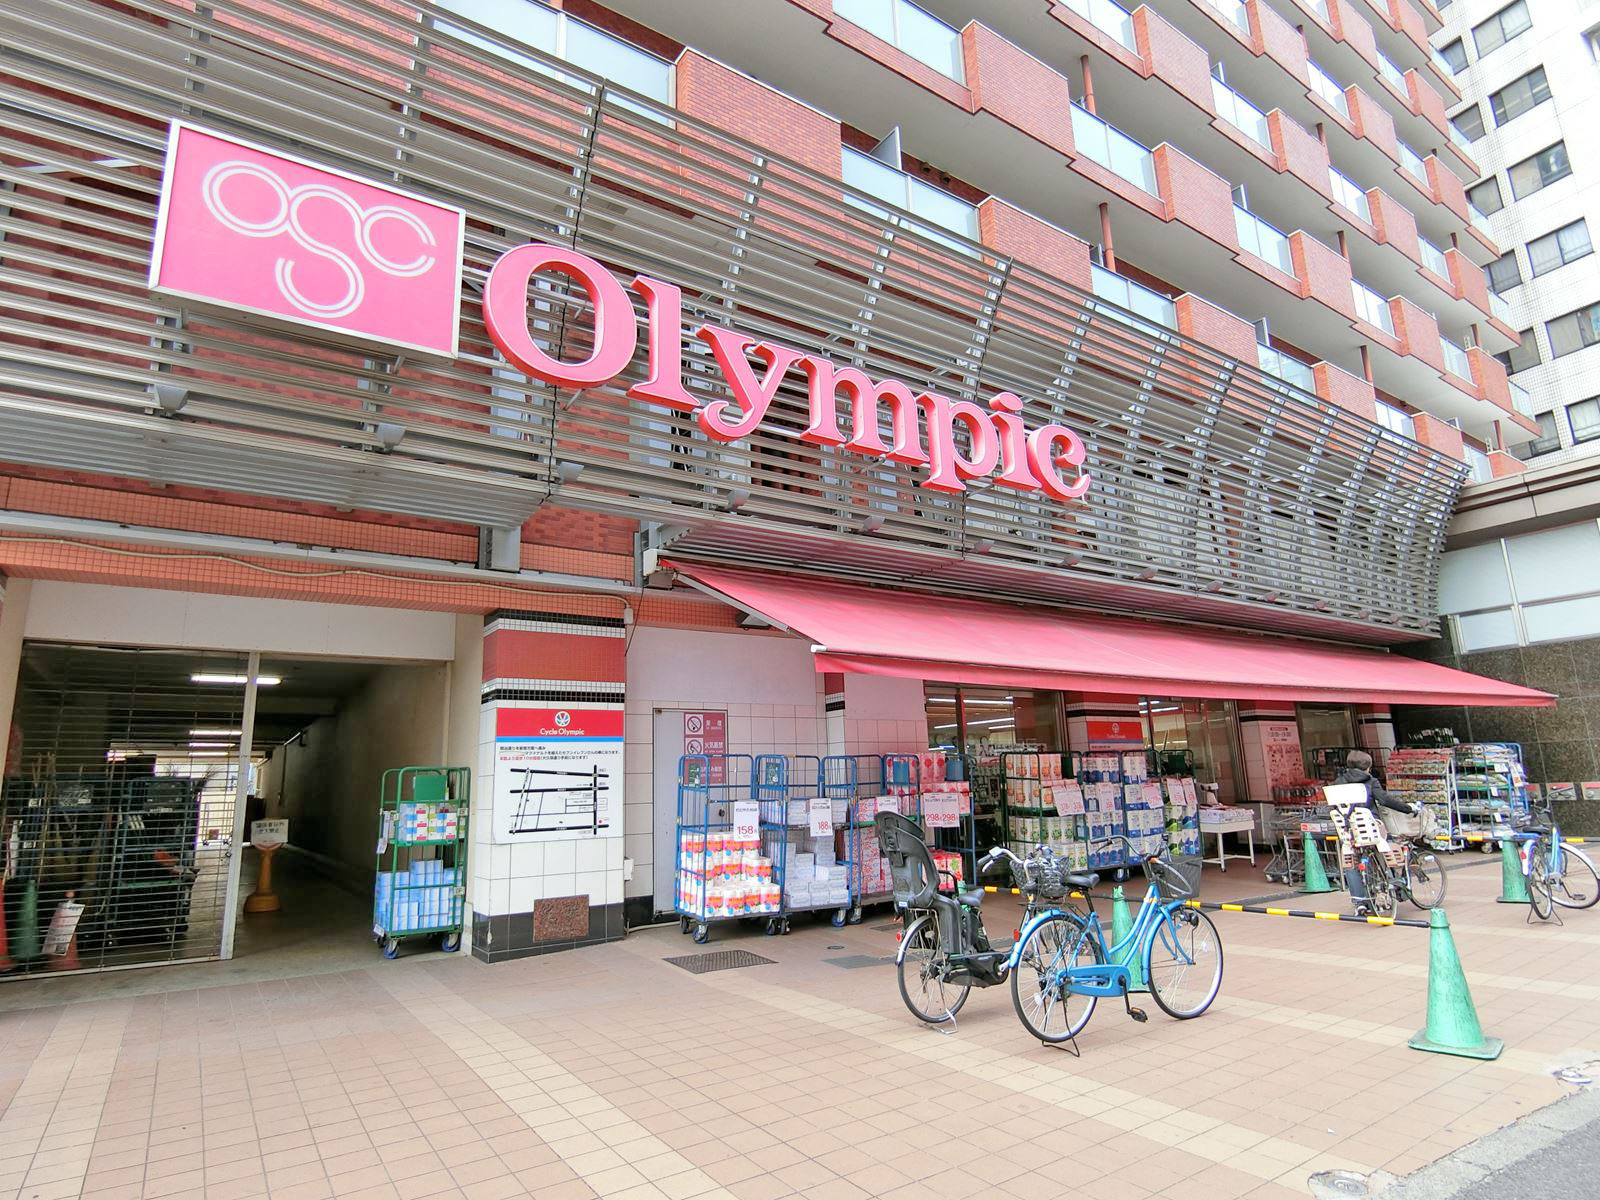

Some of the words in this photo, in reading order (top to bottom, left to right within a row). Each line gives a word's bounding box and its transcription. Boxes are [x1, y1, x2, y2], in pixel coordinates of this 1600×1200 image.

[482, 243, 1091, 502] Olympic
[539, 727, 557, 736] Cycle
[558, 727, 585, 736] Olympic
[737, 825, 754, 835] 158
